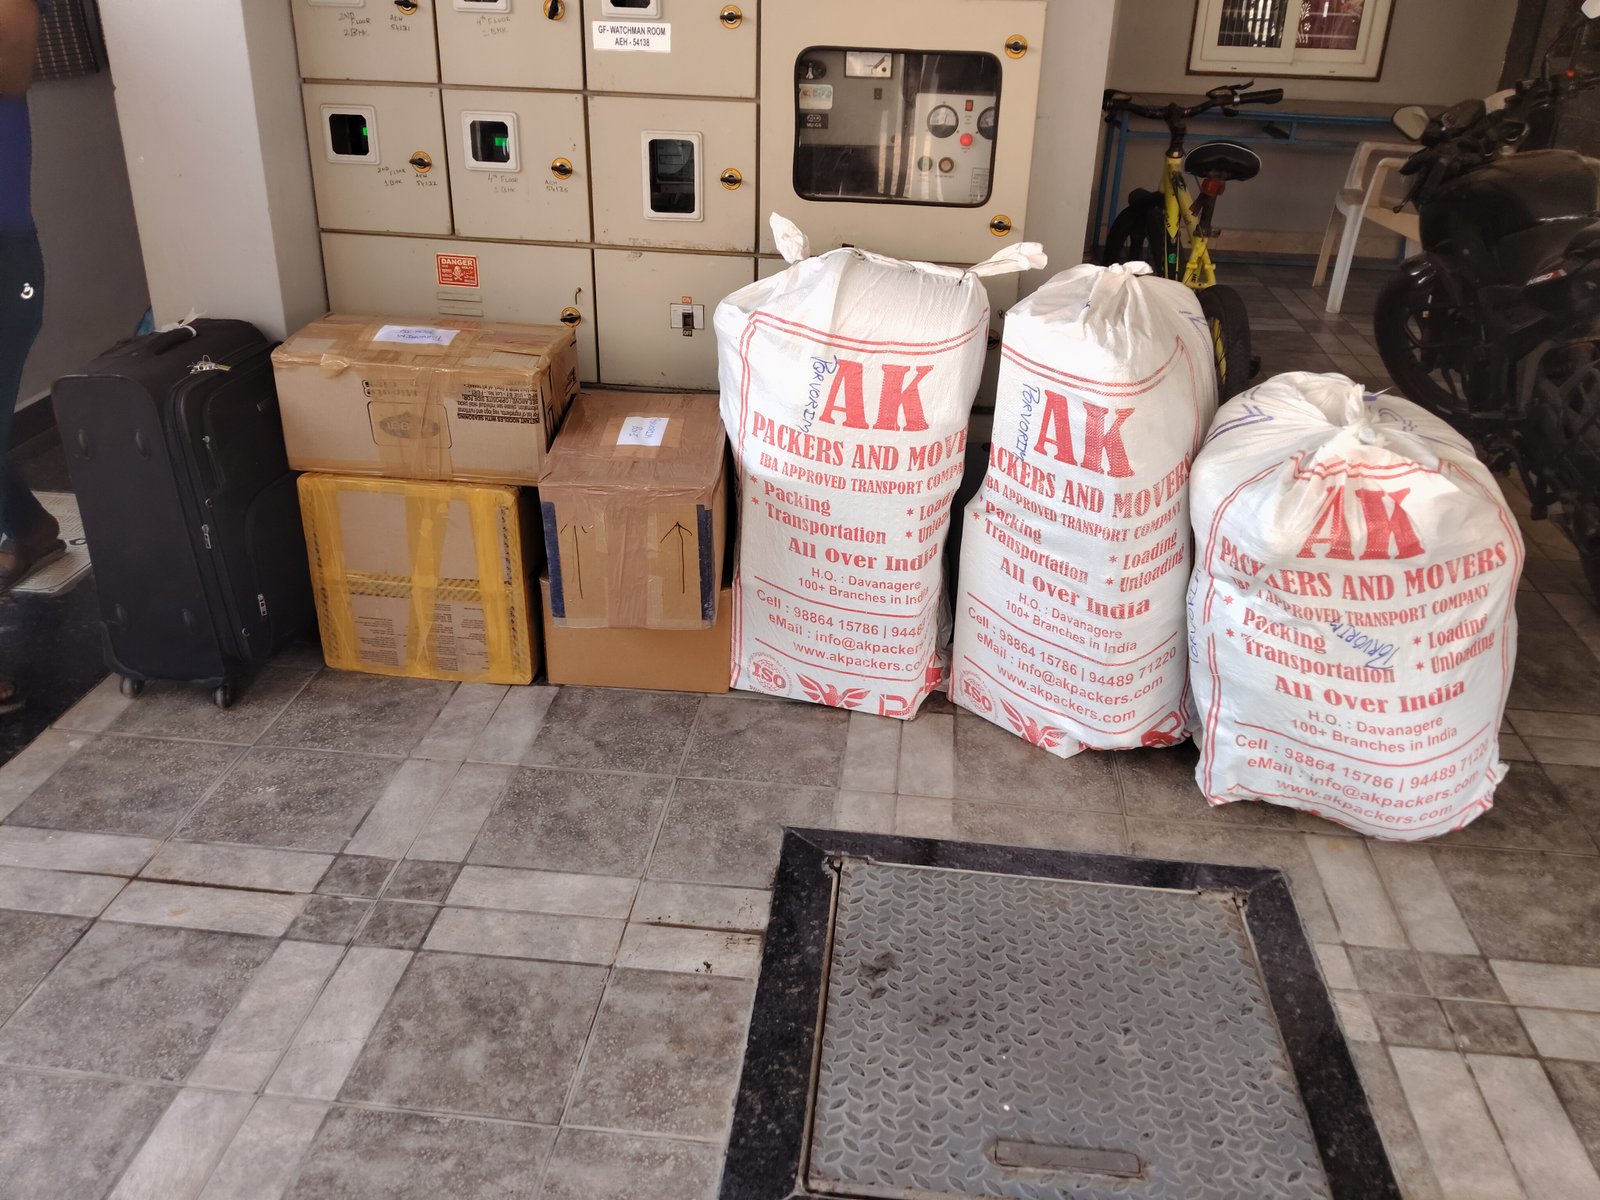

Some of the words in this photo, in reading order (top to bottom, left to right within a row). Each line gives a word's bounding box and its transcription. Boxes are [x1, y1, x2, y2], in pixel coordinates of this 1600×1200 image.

[610, 25, 646, 35] WATCHMAN
[646, 26, 667, 36] ROOM
[614, 37, 628, 46] AEH
[632, 38, 651, 47] 54138
[441, 258, 473, 266] DANGER
[819, 359, 934, 432] AK
[752, 411, 844, 469] PACKERS
[851, 444, 898, 471] AND
[1033, 389, 1136, 478] AK
[760, 451, 779, 473] IBA
[781, 461, 847, 490] APPROVED
[851, 478, 924, 495] TRANSPORT
[1062, 479, 1104, 513] AND
[1112, 450, 1192, 519] MOVERS
[764, 480, 831, 517] Packing
[1002, 485, 1057, 522] APPROVED
[1061, 512, 1131, 543] TRANSPORT
[1133, 501, 1182, 540] COMPANY
[766, 502, 887, 545] Transportation
[985, 499, 1042, 545] Packing
[1122, 528, 1178, 570] Loading
[1296, 486, 1426, 560] AK
[788, 537, 816, 559] All
[825, 547, 877, 569] Over
[886, 543, 938, 571] India
[984, 518, 1089, 585] Transportation
[1119, 543, 1185, 593] Unloading
[1342, 574, 1395, 602] AND
[1404, 541, 1507, 597] MOVERS
[798, 578, 825, 592] 100+
[829, 585, 886, 604] Branches
[890, 594, 902, 604] in
[848, 575, 921, 592] Davanagere
[1000, 556, 1026, 585] All
[1031, 574, 1080, 607] Over
[1087, 595, 1151, 620] India
[1347, 603, 1427, 628] TRANSPORT
[1432, 583, 1490, 615] COMPANY
[756, 589, 781, 610] Cell
[793, 603, 834, 627] 98864
[839, 619, 879, 636] 15786
[768, 613, 803, 635] eMail
[1005, 599, 1030, 620] 100+
[1033, 615, 1085, 646] Branches
[1089, 636, 1100, 648] in
[1104, 641, 1137, 654] India
[1051, 607, 1122, 639] Davanagere
[1243, 607, 1327, 654] Packing
[1427, 614, 1488, 649] Loading
[968, 606, 989, 629] Cell
[999, 629, 1036, 657] 98864
[1039, 651, 1077, 676] 15786
[1089, 671, 1134, 687] 94489
[1138, 646, 1177, 679] 71220
[976, 632, 1007, 660] eMail
[1017, 657, 1163, 706] info@akpackers.com
[1241, 633, 1395, 683] Transportation
[1431, 629, 1495, 674] Unloading
[751, 661, 787, 690] ISO
[963, 680, 993, 712] ISO
[996, 664, 1136, 724] www.akpackers.com
[1275, 675, 1313, 702] All
[1323, 688, 1388, 713] Over
[1398, 679, 1466, 713] India
[1291, 719, 1328, 736] 100+
[1332, 730, 1405, 753] Branches
[1410, 738, 1424, 751] in
[1427, 727, 1458, 747] India
[1356, 715, 1444, 737] Davanagere
[1235, 734, 1268, 750] Cell
[1284, 747, 1335, 773] 98864
[1342, 767, 1394, 789] 15786
[1410, 764, 1457, 789] 94489
[1247, 757, 1293, 776] eMail
[1309, 770, 1479, 809] info@akpackers.com
[1275, 779, 1453, 824] www.akpackers.com
